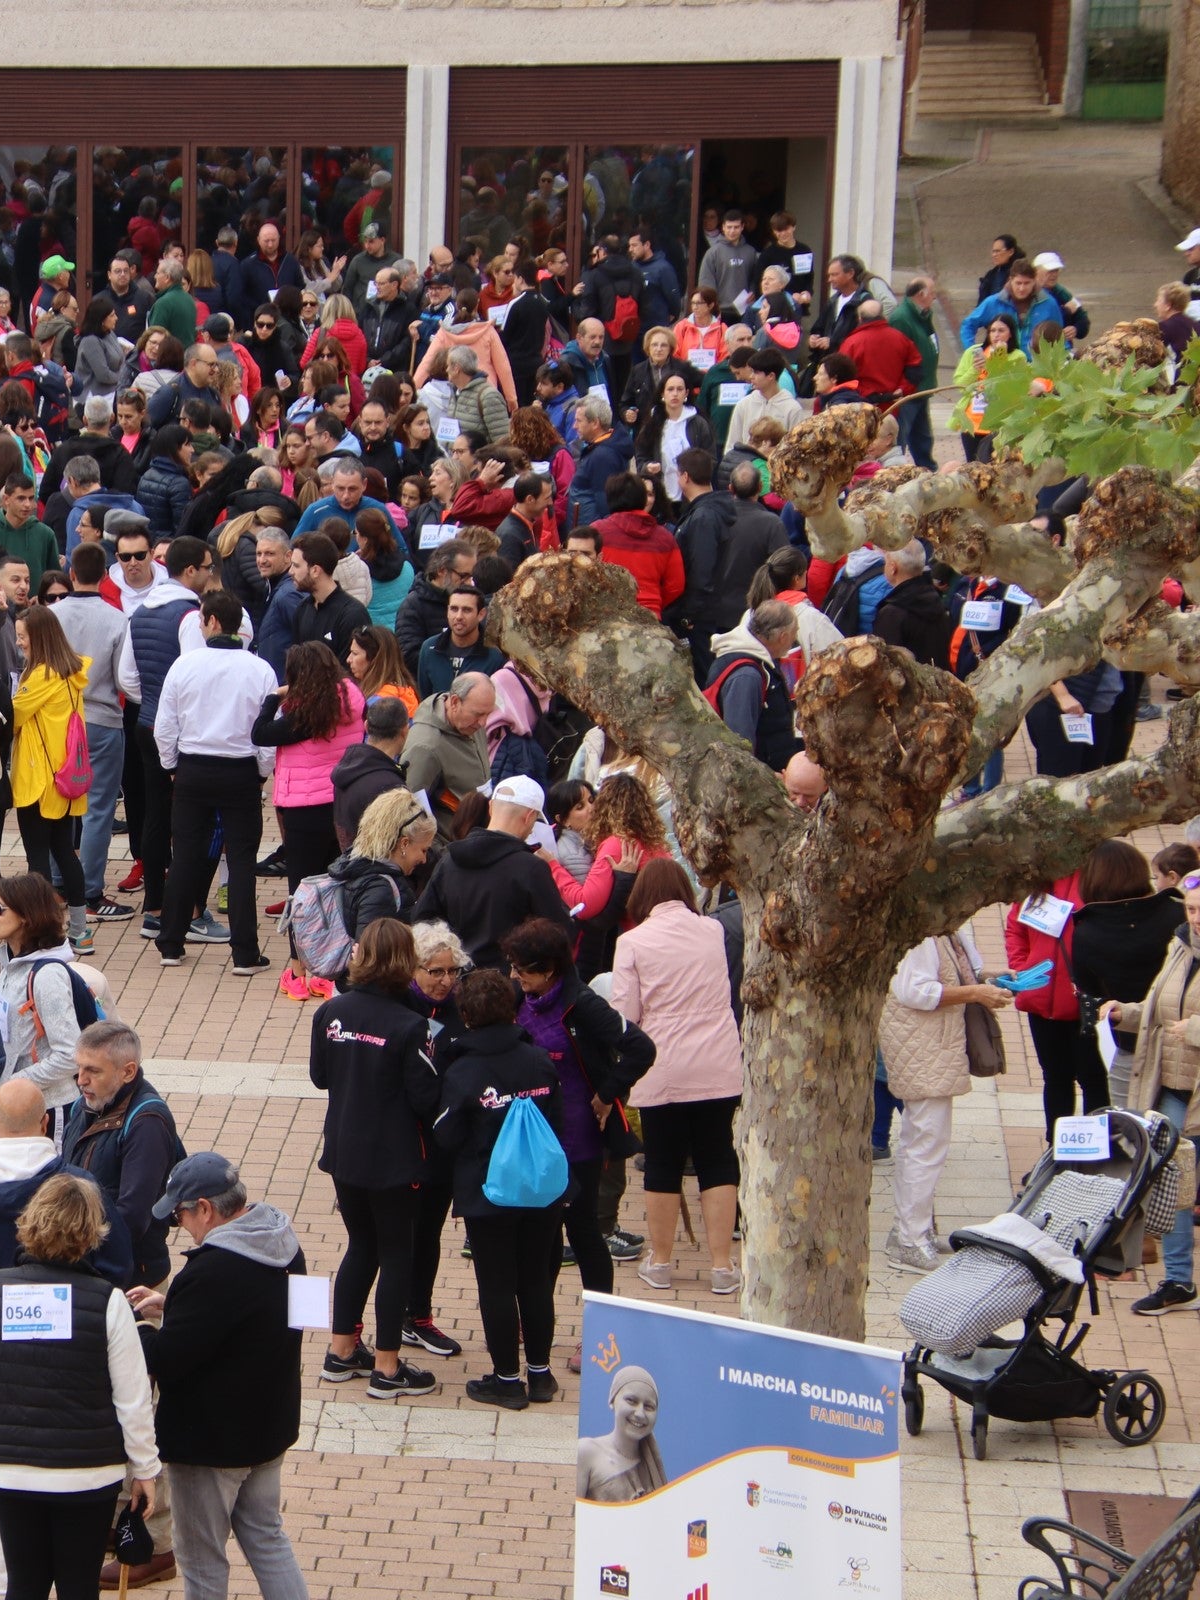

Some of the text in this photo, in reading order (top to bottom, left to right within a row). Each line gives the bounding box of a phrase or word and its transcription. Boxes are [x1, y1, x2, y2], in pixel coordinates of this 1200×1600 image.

[1060, 1132, 1093, 1144] 0467
[5, 1305, 42, 1320] 0546
[719, 1366, 885, 1415] I MARCHA SOLIDARIA
[809, 1404, 885, 1436] FAMILIAR
[791, 1453, 849, 1473] COLABORADORES
[762, 1494, 808, 1510] Castromonte
[602, 1568, 628, 1588] PCB
